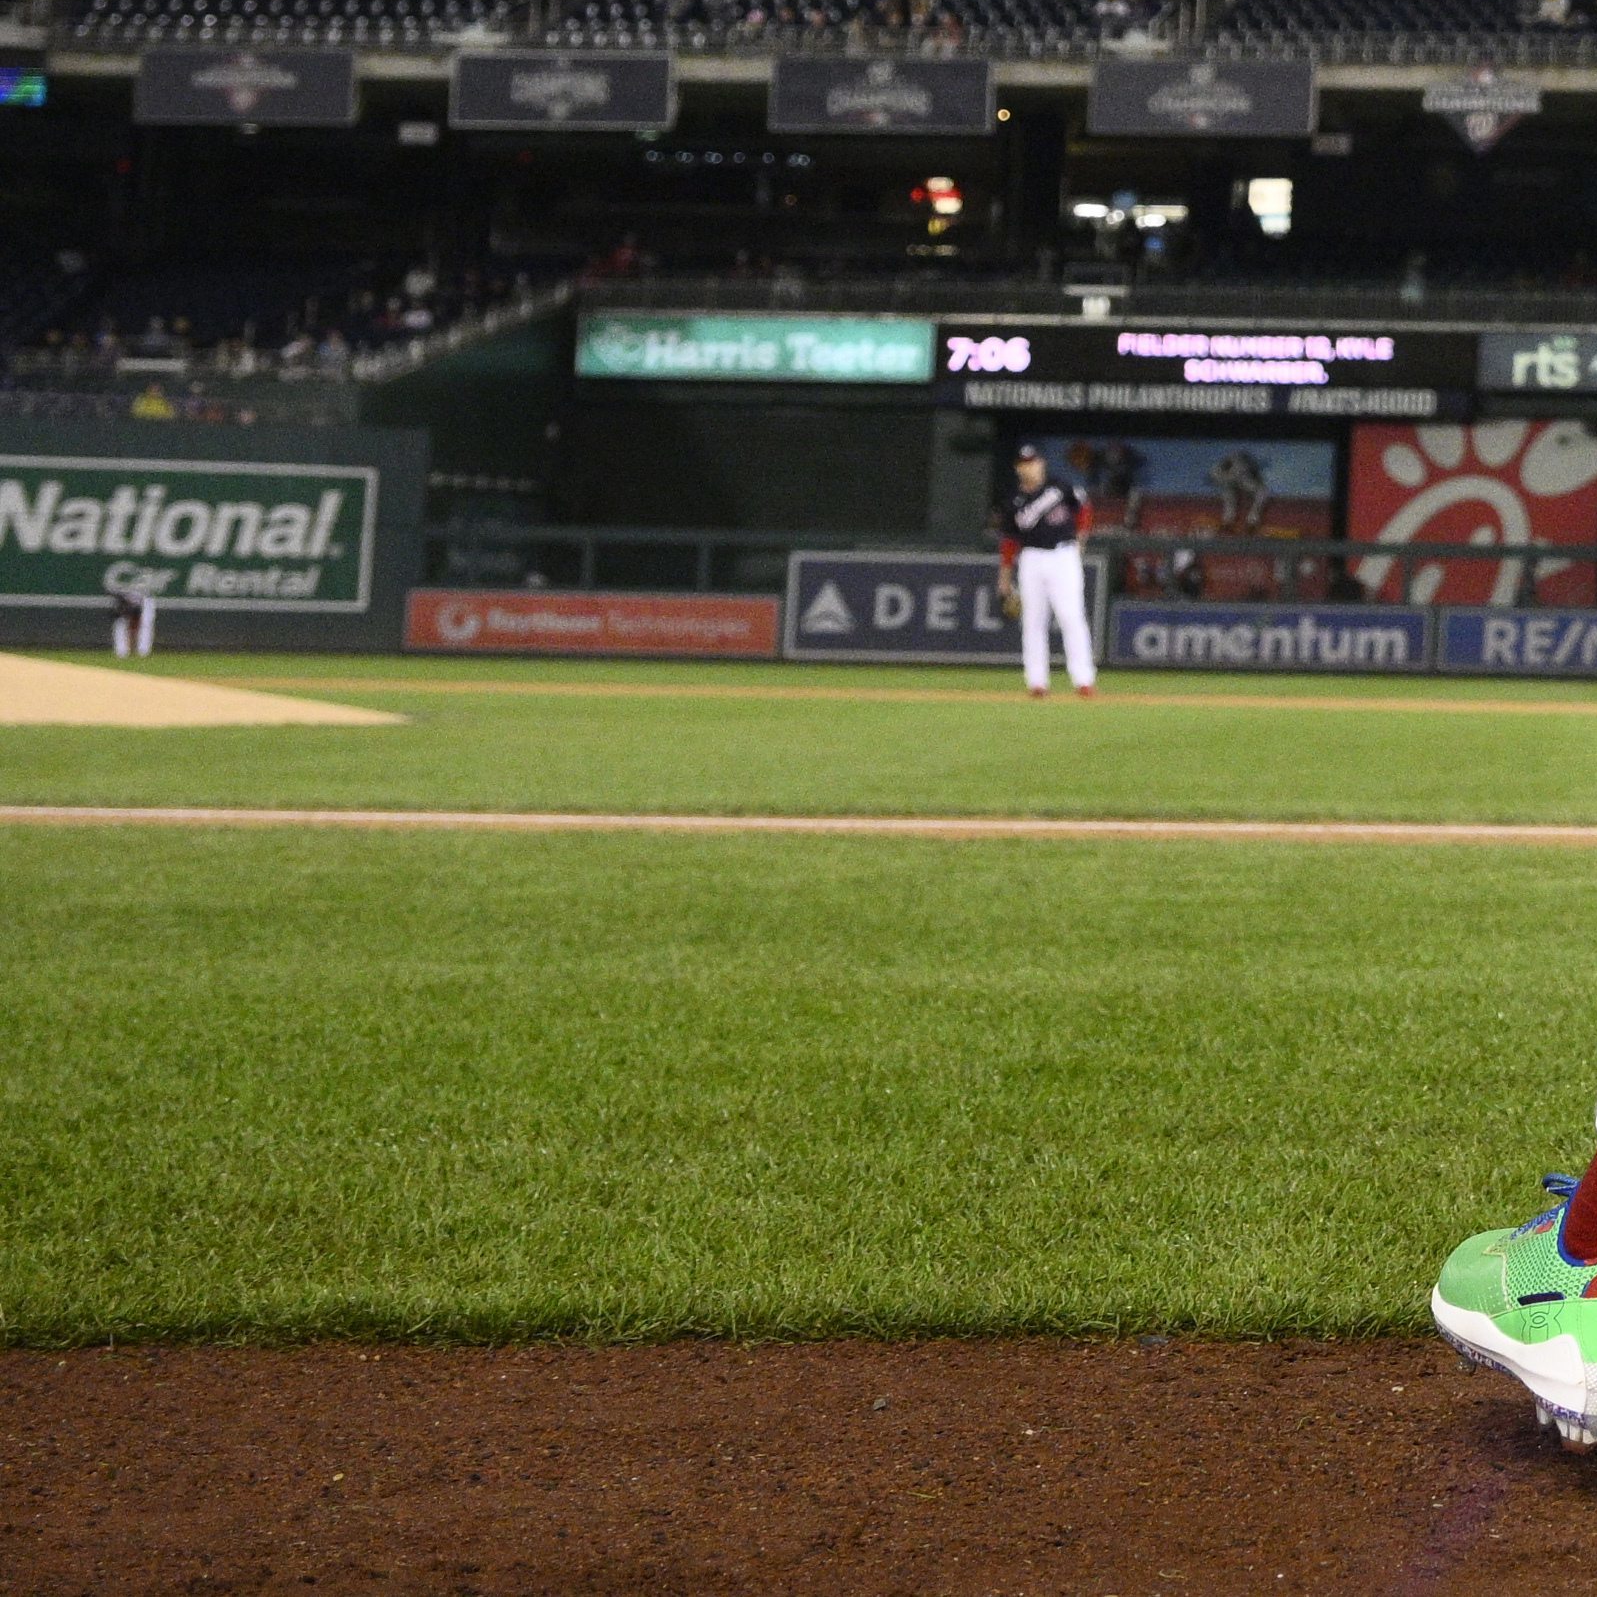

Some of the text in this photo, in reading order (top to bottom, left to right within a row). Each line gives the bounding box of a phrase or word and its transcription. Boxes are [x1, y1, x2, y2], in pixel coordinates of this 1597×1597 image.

[643, 331, 918, 372] Harris Teeter
[947, 336, 1031, 373] 7:06
[1511, 342, 1581, 389] rts
[965, 381, 1084, 409] NATIONALS
[103, 560, 321, 598] Car Rental
[1132, 613, 1409, 664] amentum
